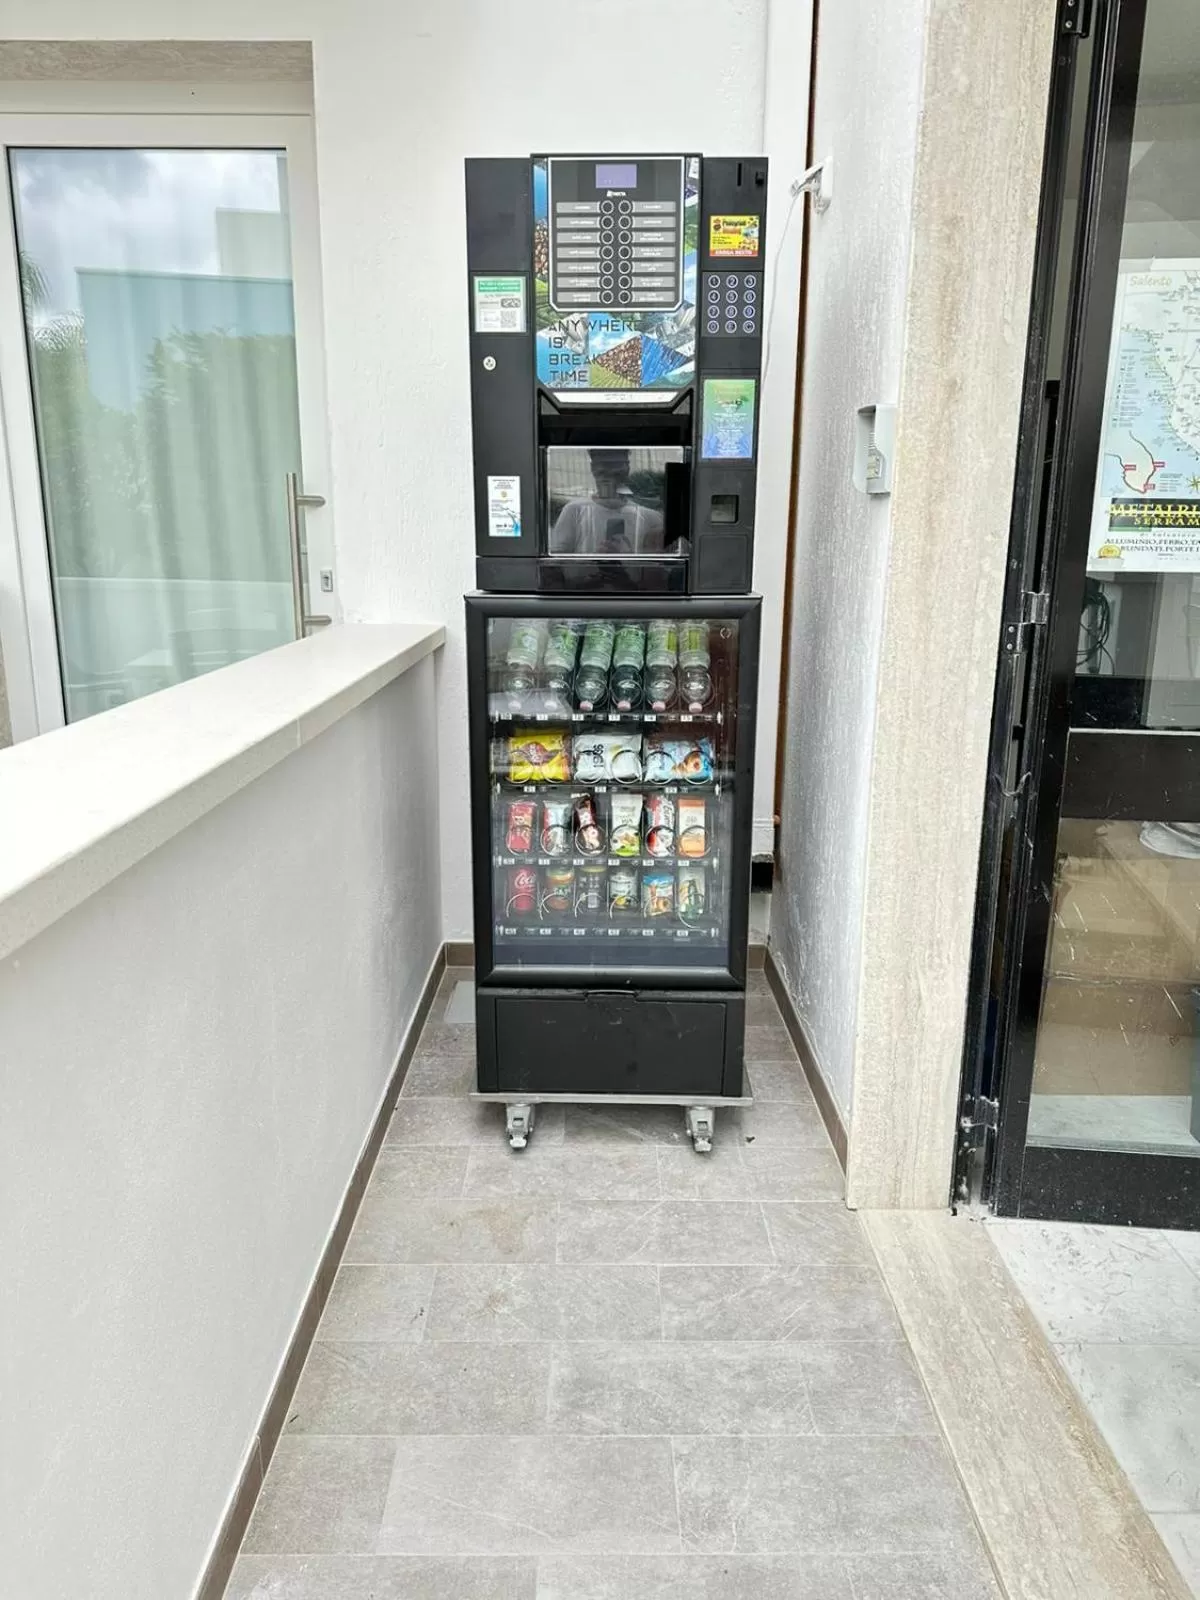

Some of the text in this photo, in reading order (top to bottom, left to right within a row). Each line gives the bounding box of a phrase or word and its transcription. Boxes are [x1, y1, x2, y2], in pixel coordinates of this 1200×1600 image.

[549, 319, 643, 332] ANYWHERE
[549, 336, 564, 348] IS
[549, 353, 600, 366] BREAK
[549, 370, 589, 382] TIME
